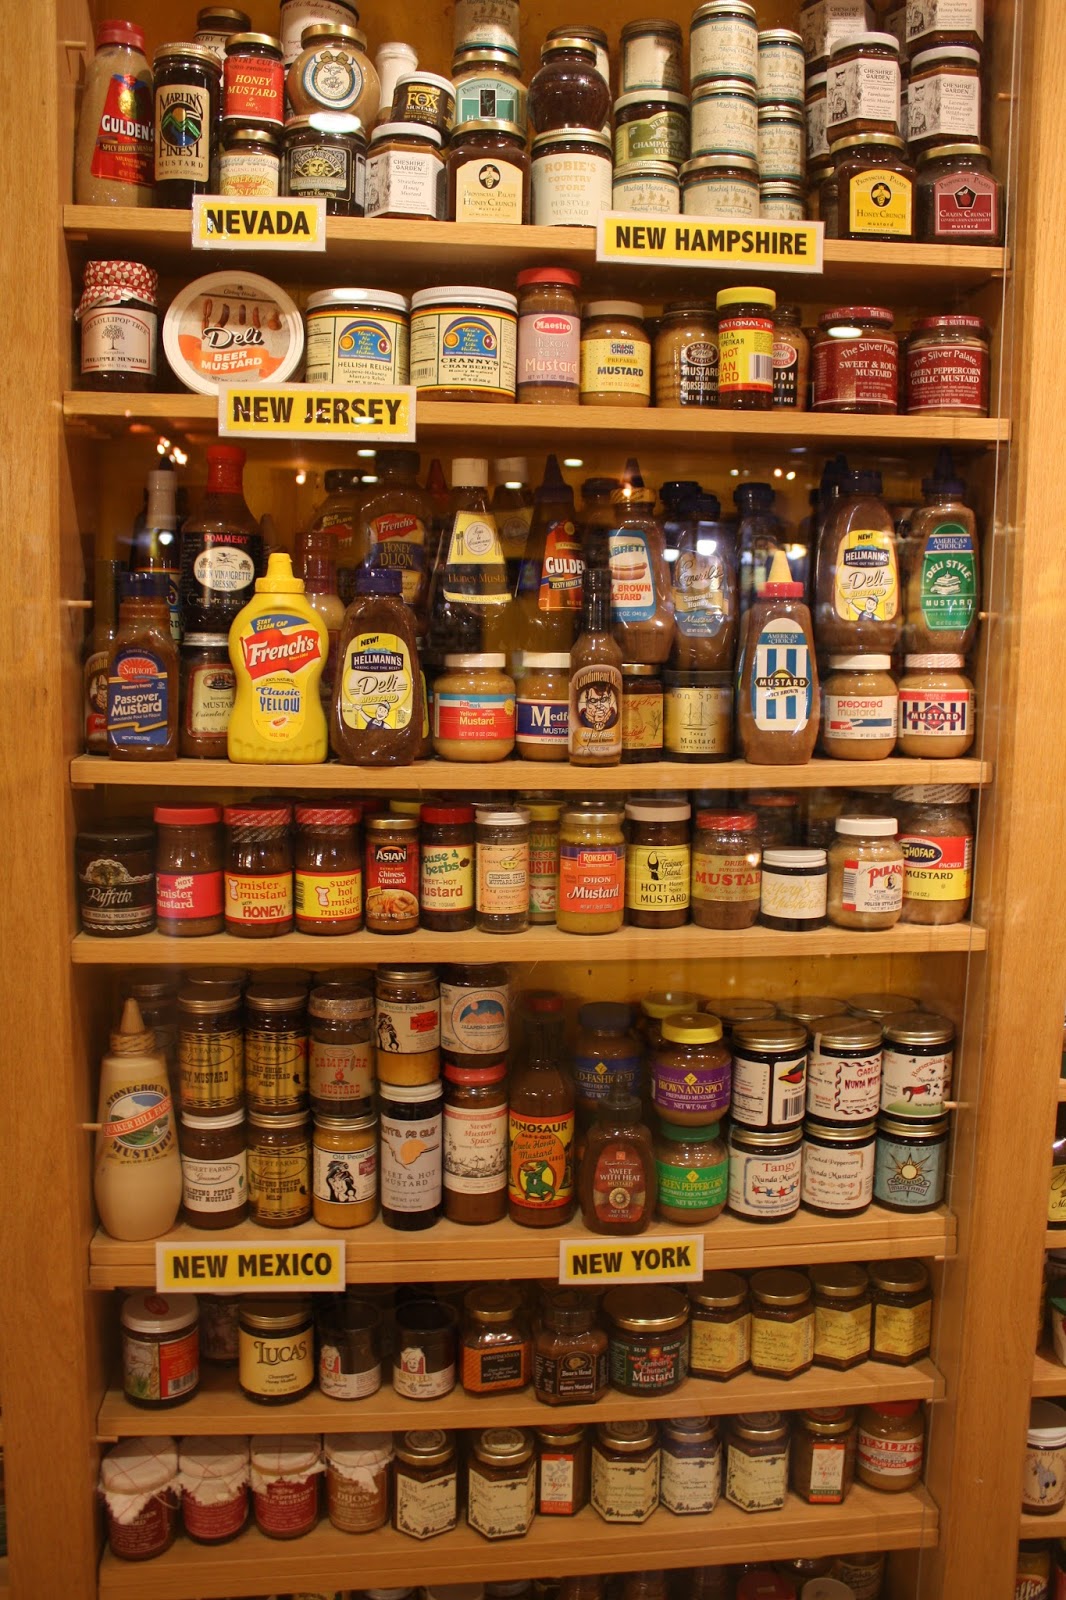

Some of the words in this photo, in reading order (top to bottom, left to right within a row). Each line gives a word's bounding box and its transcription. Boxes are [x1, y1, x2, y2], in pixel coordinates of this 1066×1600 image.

[235, 74, 272, 86] HONEY
[227, 86, 278, 98] MUSTARD
[159, 92, 203, 121] MARLIN'S
[407, 92, 440, 110] FOX
[406, 105, 439, 114] MUSTARD
[158, 160, 204, 169] MUSTARD
[393, 159, 426, 167] CHESHIRE
[395, 164, 423, 172] GARDEN
[544, 160, 596, 173] ROBIE'S
[548, 175, 592, 183] COUNTRY
[555, 184, 585, 192] STORE
[856, 209, 880, 219] HONEY
[879, 210, 906, 220] CRUNCH
[963, 209, 992, 218] CRUNCH
[207, 210, 310, 234] NEVADA
[617, 226, 667, 250] NEW
[676, 229, 807, 255] HAMPSHIRE
[535, 320, 571, 331] Maestro
[203, 326, 264, 349] Deli
[213, 349, 248, 362] BEER
[611, 348, 634, 356] UNION
[722, 347, 739, 359] HOT
[117, 356, 147, 364] MUSTARD
[201, 357, 263, 371] MUSTARD
[440, 357, 500, 367] CRANNY'S
[914, 356, 927, 369] The
[928, 350, 952, 361] Silver
[338, 361, 368, 370] HELLISH
[369, 363, 393, 372] RELISH
[442, 364, 499, 372] CRANBERRY
[525, 358, 578, 374] Mustard
[596, 366, 644, 377] MUSTARD
[855, 369, 892, 379] MUSTARD
[910, 368, 932, 377] GREEN
[933, 367, 981, 376] PEPPERCORN
[911, 375, 939, 385] GARLIC
[940, 374, 980, 384] MUSTARD
[234, 397, 293, 422] NEW
[304, 398, 402, 425] JERSEY
[379, 517, 414, 534] French's
[203, 533, 249, 545] POMMERY
[857, 533, 874, 541] NEW!
[383, 543, 411, 554] HONEY
[379, 553, 414, 567] DIJON
[845, 552, 889, 563] HELLMANN'S
[926, 562, 946, 580] DELI
[946, 559, 972, 581] STYLE
[212, 580, 238, 589] DRESSING
[848, 569, 885, 590] Deli
[617, 583, 651, 592] BROWN
[925, 598, 973, 607] MUSTARD
[256, 623, 275, 631] CLEAN
[275, 620, 289, 628] CAP
[360, 635, 380, 647] NEW!
[248, 636, 315, 668] French's
[353, 655, 402, 667] HELLMANN'S
[122, 663, 154, 675] Savion
[357, 674, 399, 695] Deli
[759, 678, 806, 688] MUSTARD
[255, 686, 300, 697] Classic
[114, 692, 159, 704] Passover
[111, 699, 162, 717] Mustard
[259, 696, 300, 713] YELLOW
[837, 700, 883, 709] prepared
[837, 708, 876, 717] mustard
[910, 712, 960, 720] MUSTARD
[459, 716, 495, 726] Mustard
[680, 737, 716, 745] Mustard
[375, 849, 407, 861] ASIAN
[583, 854, 613, 864] ROKEACH
[378, 870, 406, 879] Chinese
[583, 876, 611, 884] DIJON
[905, 870, 954, 880] MUSTARD
[177, 878, 191, 886] HOT
[239, 881, 279, 890] mister
[329, 878, 357, 887] sweet
[377, 876, 407, 885] Mustard
[337, 886, 353, 896] hot
[566, 885, 620, 900] Mustard
[640, 883, 667, 893] HOT!
[86, 887, 133, 907] Raffetto
[160, 889, 193, 899] mister
[239, 888, 287, 900] mustard
[640, 893, 687, 904] MUSTARD
[330, 896, 360, 907] mister
[242, 904, 283, 918] HONEY
[320, 905, 361, 917] mustard
[319, 1084, 361, 1095] MUSTARD
[658, 1081, 684, 1092] BROWN
[684, 1084, 705, 1095] AND
[705, 1081, 724, 1093] SPICY
[105, 1084, 168, 1106] STONEGROUND
[469, 1123, 493, 1131] Sweet
[510, 1119, 569, 1133] DINOSAUR
[463, 1128, 497, 1138] Mustard
[111, 1131, 172, 1160] MUSTARD
[470, 1136, 491, 1146] Spice
[332, 1153, 345, 1161] Old
[519, 1148, 553, 1160] Mustard
[761, 1161, 797, 1174] Tangy
[599, 1174, 620, 1182] WITH
[620, 1174, 641, 1182] HEAT
[828, 1170, 859, 1179] Mustard
[681, 1179, 723, 1191] PEPPERCORN
[173, 1255, 228, 1279] NEW
[239, 1252, 332, 1277] MEXICO
[573, 1251, 623, 1276] NEW
[632, 1246, 691, 1271] YORK
[253, 1341, 308, 1366] LUCAS
[632, 1371, 675, 1383] Mustard
[337, 1491, 370, 1503] DIJON
